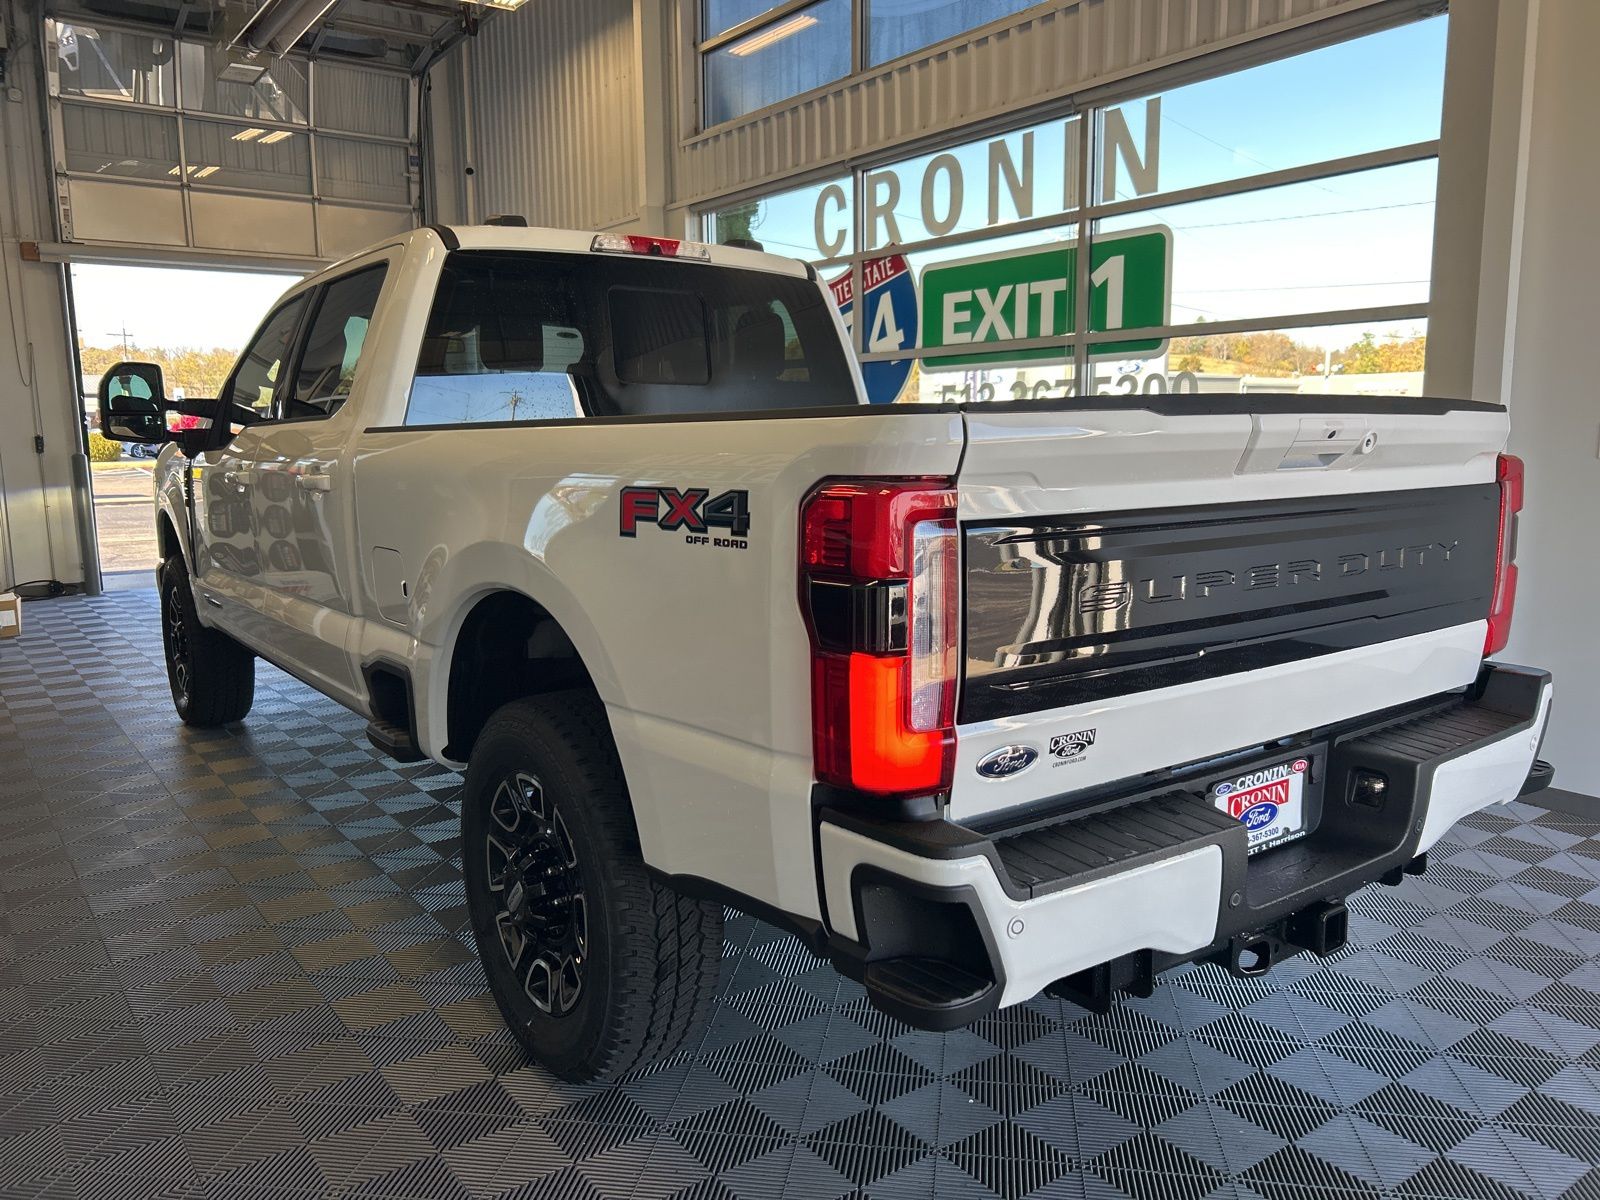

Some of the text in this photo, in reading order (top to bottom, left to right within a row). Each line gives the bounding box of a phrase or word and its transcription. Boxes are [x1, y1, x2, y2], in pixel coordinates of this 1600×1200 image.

[814, 97, 1161, 258] CRONIN
[942, 254, 1126, 346] EXIT 1
[619, 485, 750, 538] FX4
[685, 535, 748, 549] OFF ROAD
[1079, 540, 1459, 614] SUPER DUTY
[1050, 729, 1096, 750] CRONIN
[1061, 743, 1081, 757] Ford
[993, 749, 1027, 772] Ford
[1230, 782, 1288, 819] CRONIN
[1246, 806, 1271, 828] Ford
[1261, 843, 1268, 851] 1
[1269, 830, 1306, 848] Harrison
